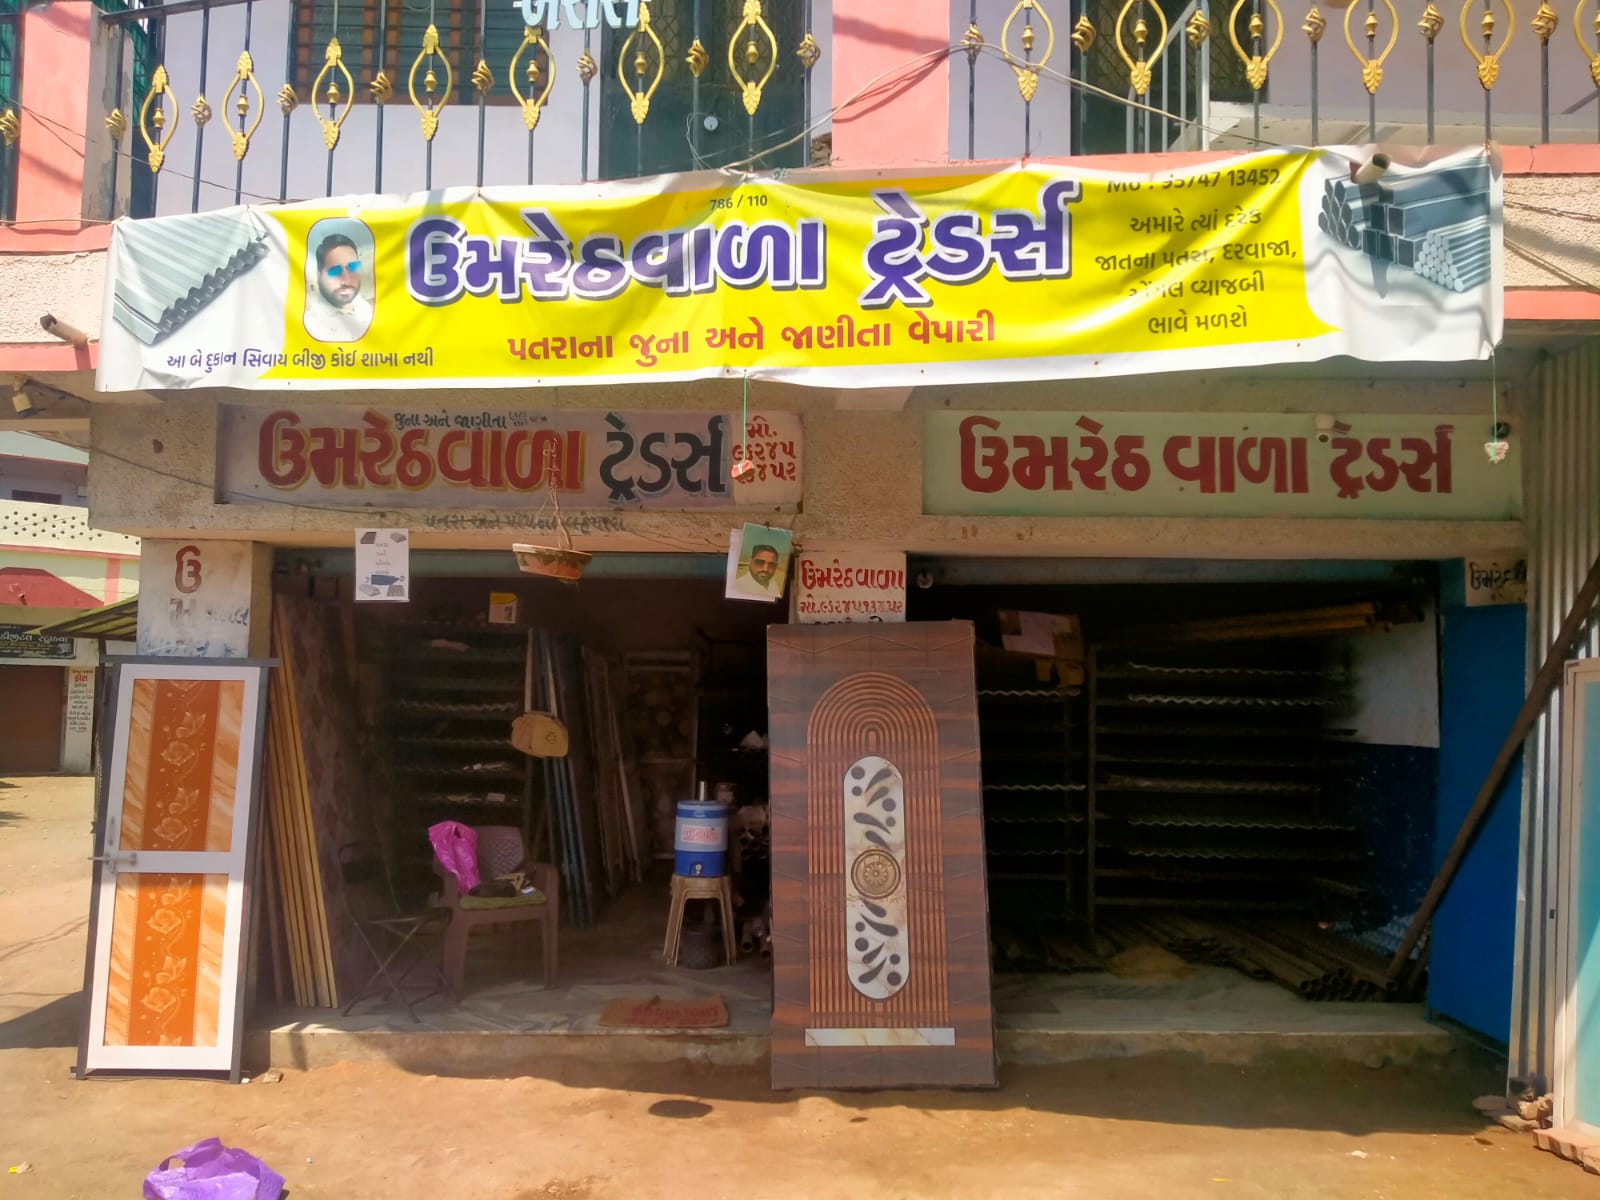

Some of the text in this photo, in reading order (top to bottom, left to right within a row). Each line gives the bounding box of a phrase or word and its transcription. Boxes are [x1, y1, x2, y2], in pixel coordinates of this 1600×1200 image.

[1227, 169, 1281, 187] 13452
[710, 197, 733, 210] 786
[746, 194, 768, 208] 110
[1129, 205, 1262, 234] અમારે ત્યાં દરેક
[407, 178, 1081, 308] ઉમરેઠવાળા ટ્રેડર્સ
[1095, 252, 1156, 271] જાતના
[1191, 270, 1265, 297] વ્યાજબી
[1148, 305, 1247, 334] ભાવે મળશે
[507, 309, 995, 368] પતરાના જુના અને જાણીતા વેપારી
[167, 347, 434, 374] આ બે દુકાન સિવાય બીજી કોઈ શાખા નથી
[258, 408, 729, 501] ઉમરેઠવાળા ટ્રેડર્સ
[1329, 419, 1454, 499] ટ્રેડર્સ
[800, 558, 905, 591] ઉમરેઠવાળા
